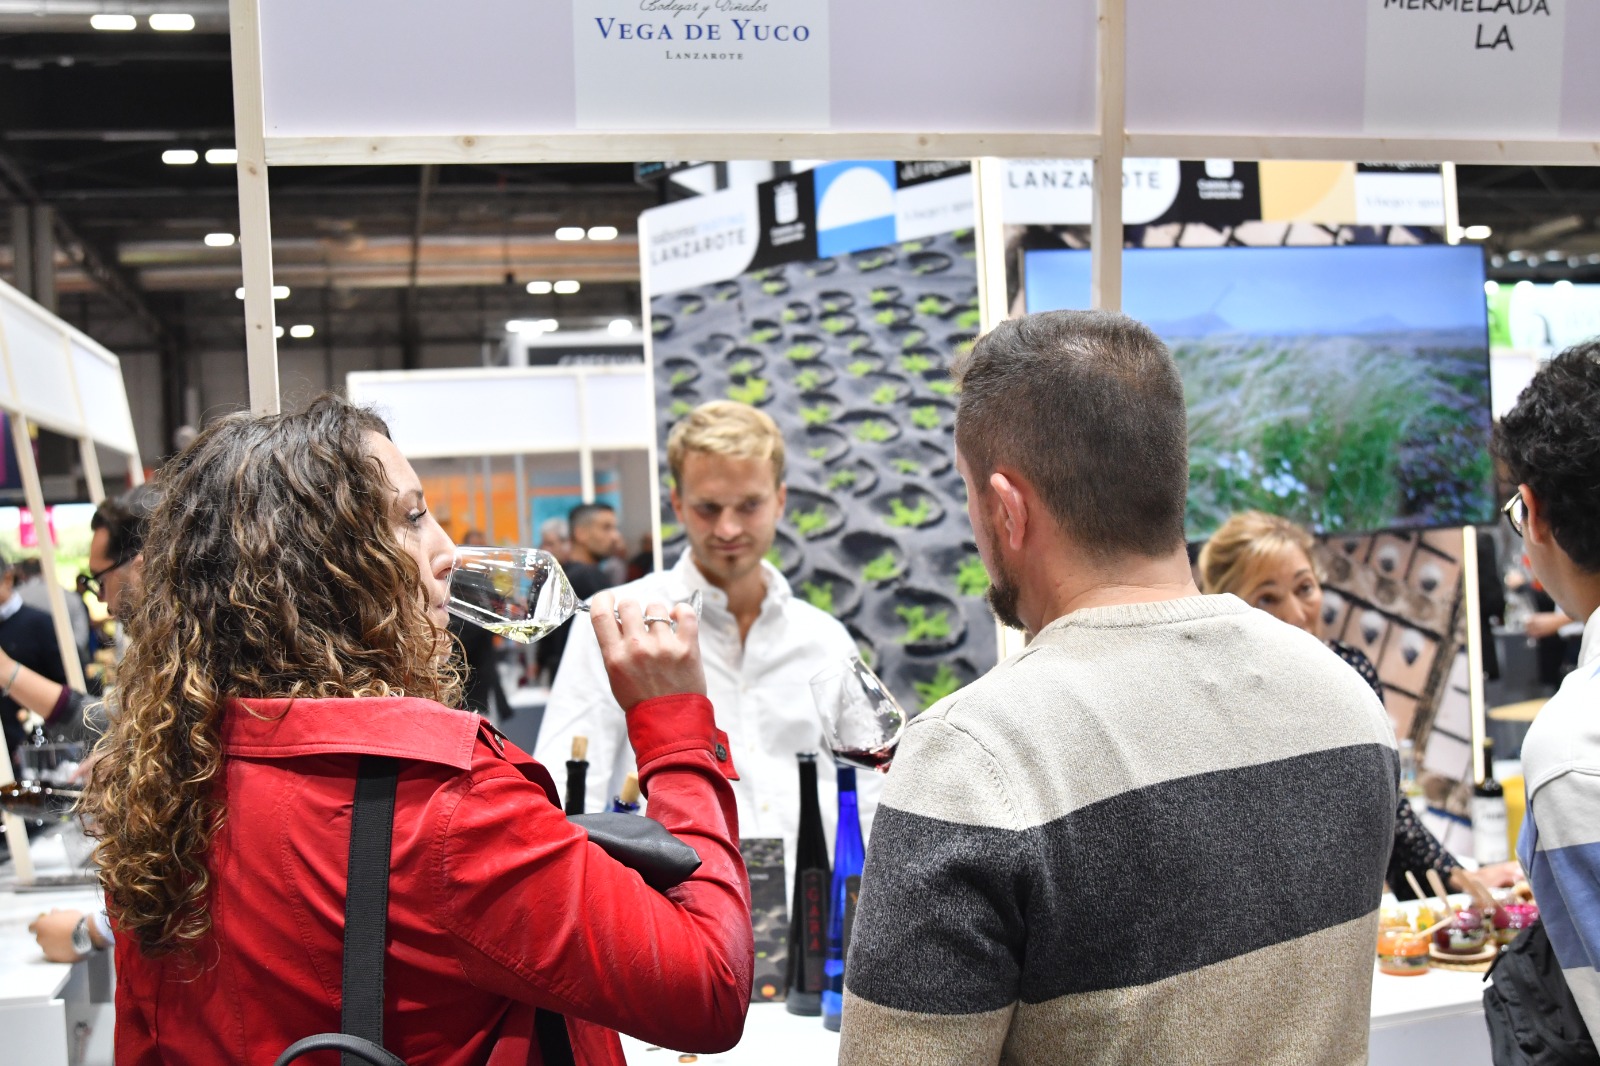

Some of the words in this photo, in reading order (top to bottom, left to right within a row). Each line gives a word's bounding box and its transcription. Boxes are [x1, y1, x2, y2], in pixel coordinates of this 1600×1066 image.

[640, 0, 698, 17] Bodegas
[696, 5, 710, 19] y
[595, 17, 674, 40] VEGA
[685, 23, 721, 41] DE
[731, 19, 811, 42] YUCO
[1475, 23, 1514, 51] LA
[665, 50, 744, 60] LANZAROTE
[651, 228, 746, 266] LANZAROTE
